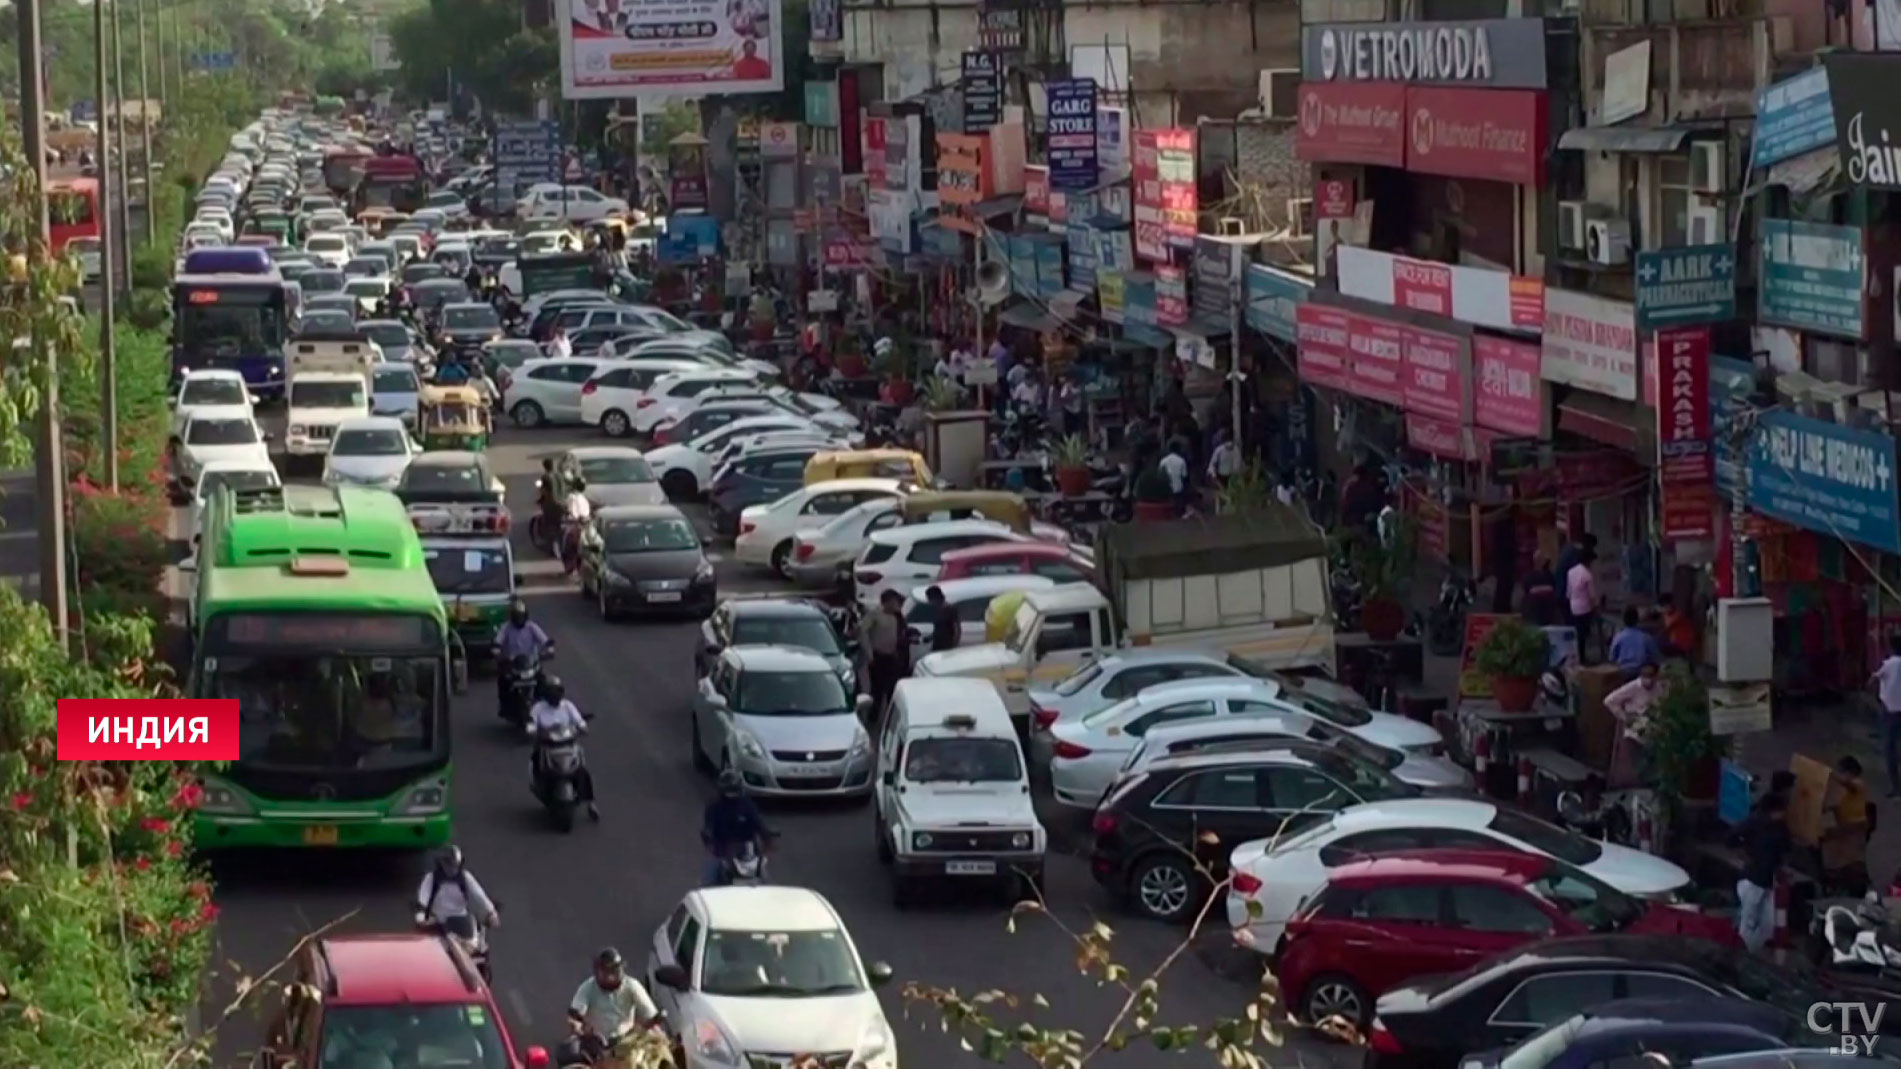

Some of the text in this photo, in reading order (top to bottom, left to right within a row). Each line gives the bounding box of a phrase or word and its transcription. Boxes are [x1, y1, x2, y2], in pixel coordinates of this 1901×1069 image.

[1340, 27, 1491, 79] VETROMODA
[1052, 99, 1091, 115] GARG
[1050, 118, 1093, 133] STORE
[1483, 121, 1526, 152] Finance
[1660, 254, 1713, 282] AARK
[1672, 341, 1695, 440] PRAKASH
